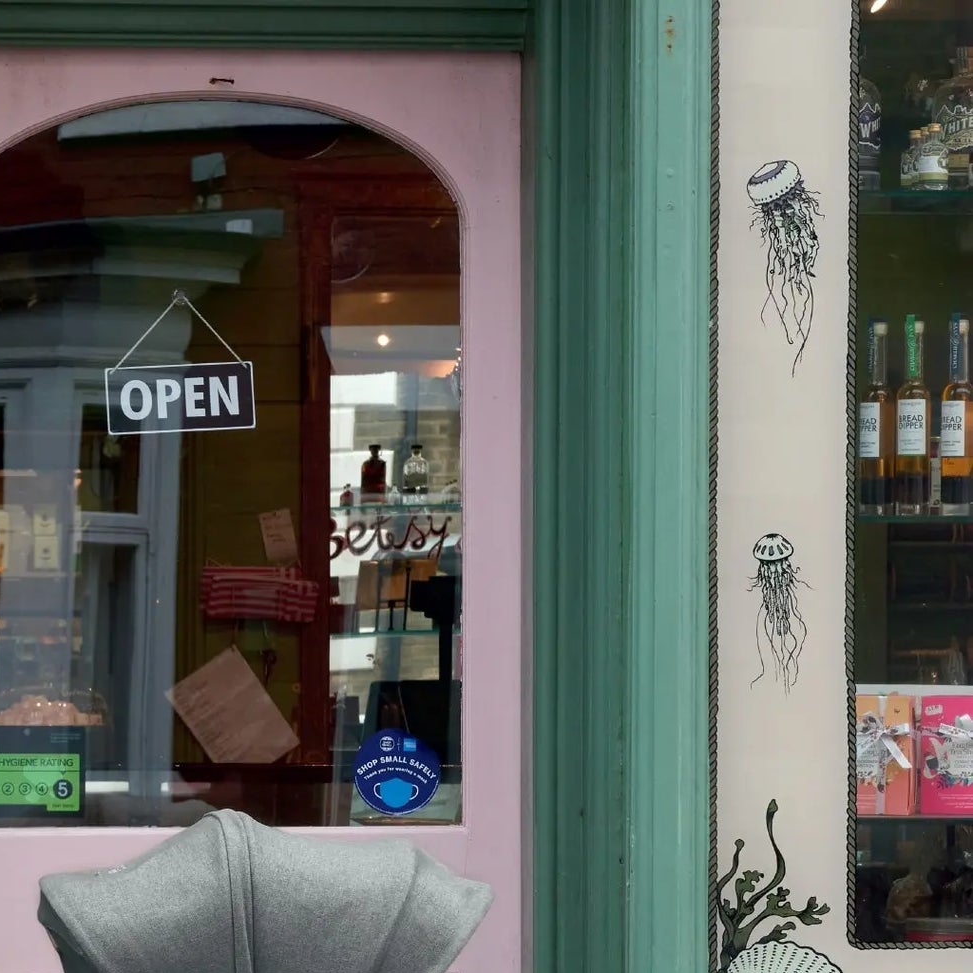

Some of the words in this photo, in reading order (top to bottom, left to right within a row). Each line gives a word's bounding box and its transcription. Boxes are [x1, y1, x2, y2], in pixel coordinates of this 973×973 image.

[120, 375, 240, 421] OPEN
[898, 414, 924, 422] BREAD
[898, 422, 924, 430] DIPPER
[40, 758, 74, 767] RATING
[356, 759, 378, 776] SHOP
[379, 755, 408, 764] SMALL
[409, 758, 437, 779] SAFELY
[57, 782, 68, 797] 5
